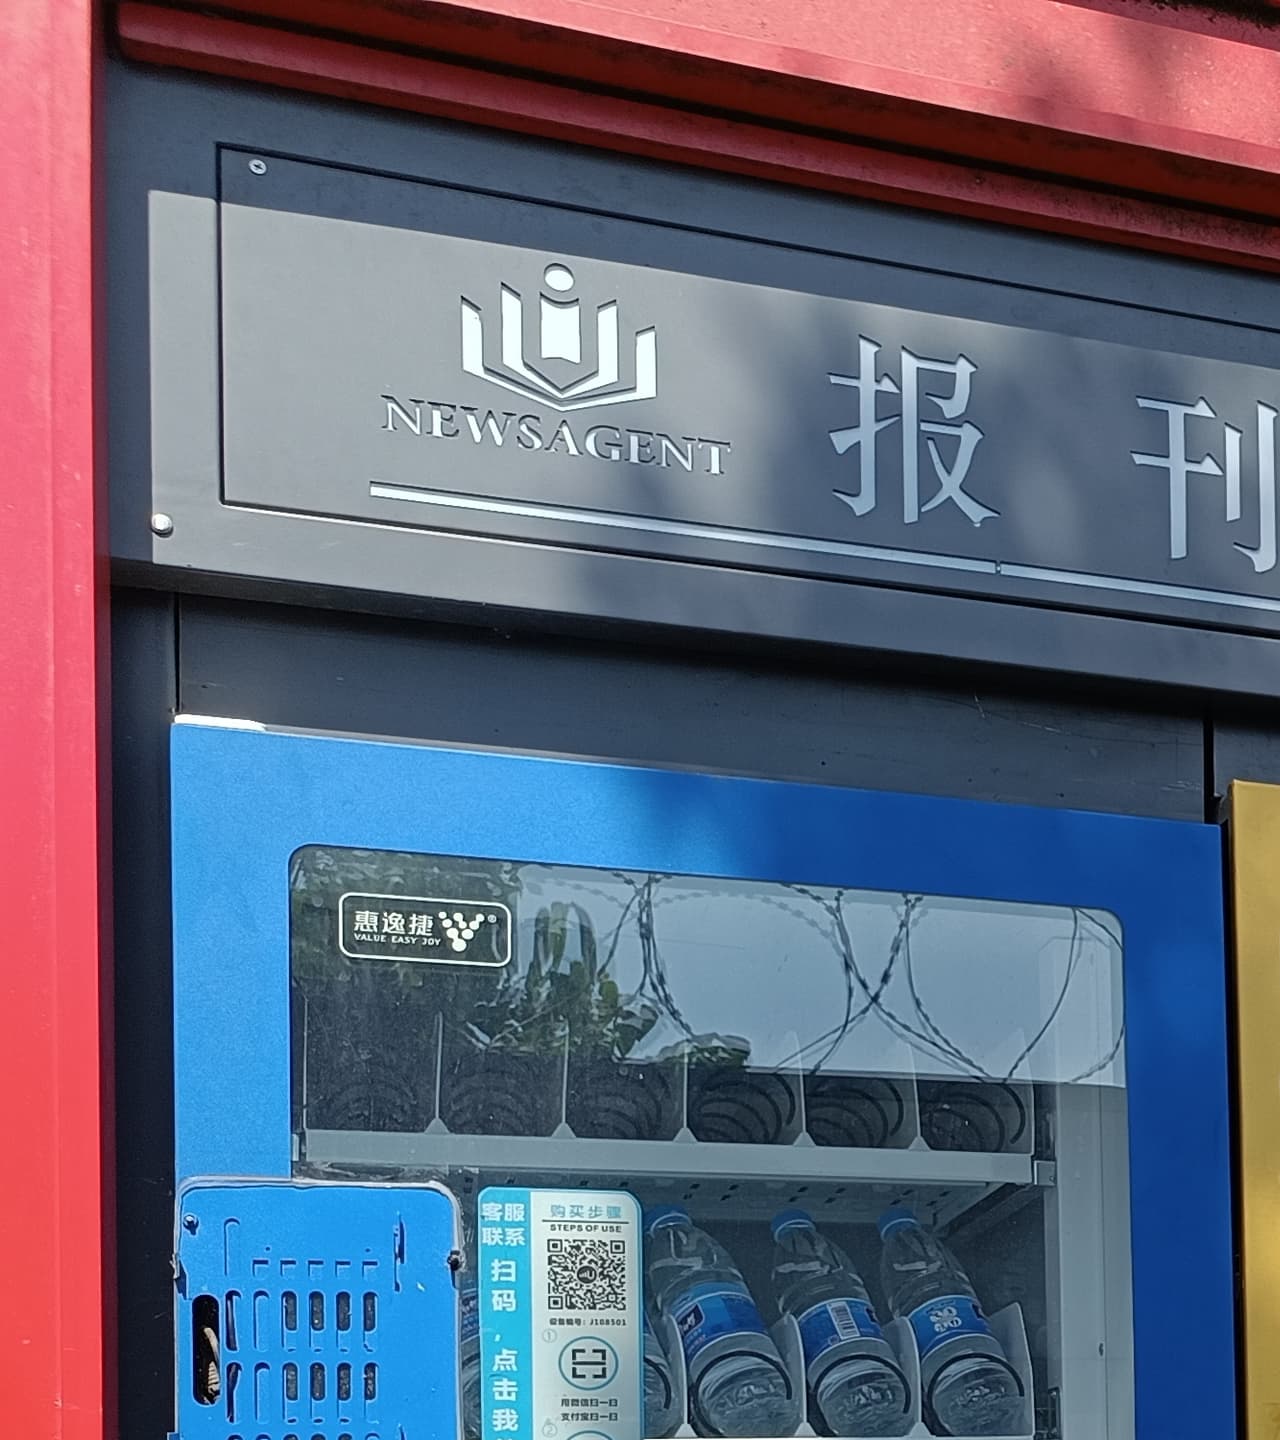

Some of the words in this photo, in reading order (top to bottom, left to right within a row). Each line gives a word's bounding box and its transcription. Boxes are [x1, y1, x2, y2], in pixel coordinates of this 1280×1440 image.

[380, 395, 731, 476] NEWSAGENT
[353, 910, 434, 936] 惠逸捷
[354, 933, 386, 942] VALUE
[391, 936, 417, 945] EASY
[422, 938, 441, 946] JOY
[481, 1203, 526, 1223] 客服
[481, 1227, 526, 1248] 联系
[550, 1223, 584, 1233] STEPS
[585, 1224, 599, 1233] OF
[601, 1224, 623, 1233] USE
